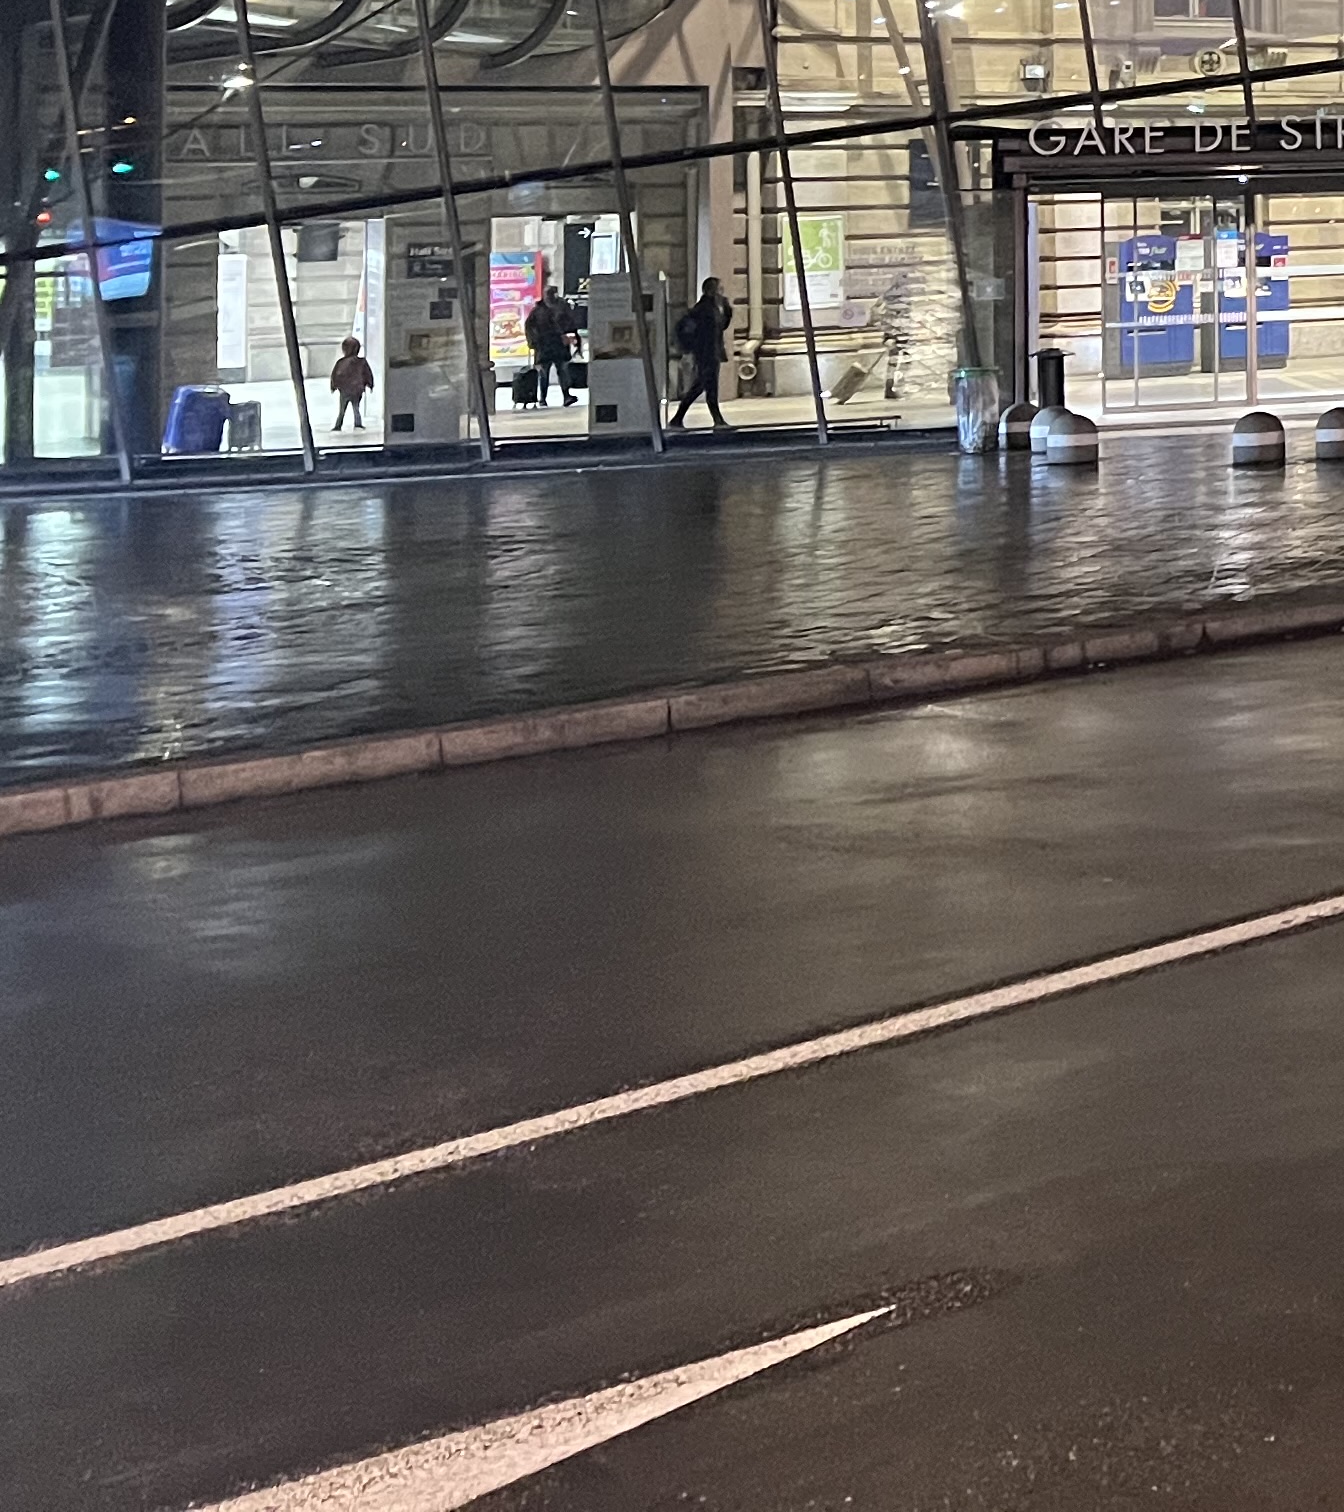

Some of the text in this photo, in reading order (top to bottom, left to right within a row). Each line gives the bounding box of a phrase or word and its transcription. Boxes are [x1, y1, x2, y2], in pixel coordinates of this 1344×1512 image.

[358, 122, 487, 155] SUD
[1027, 118, 1166, 156] GARE
[1194, 115, 1252, 153] DE
